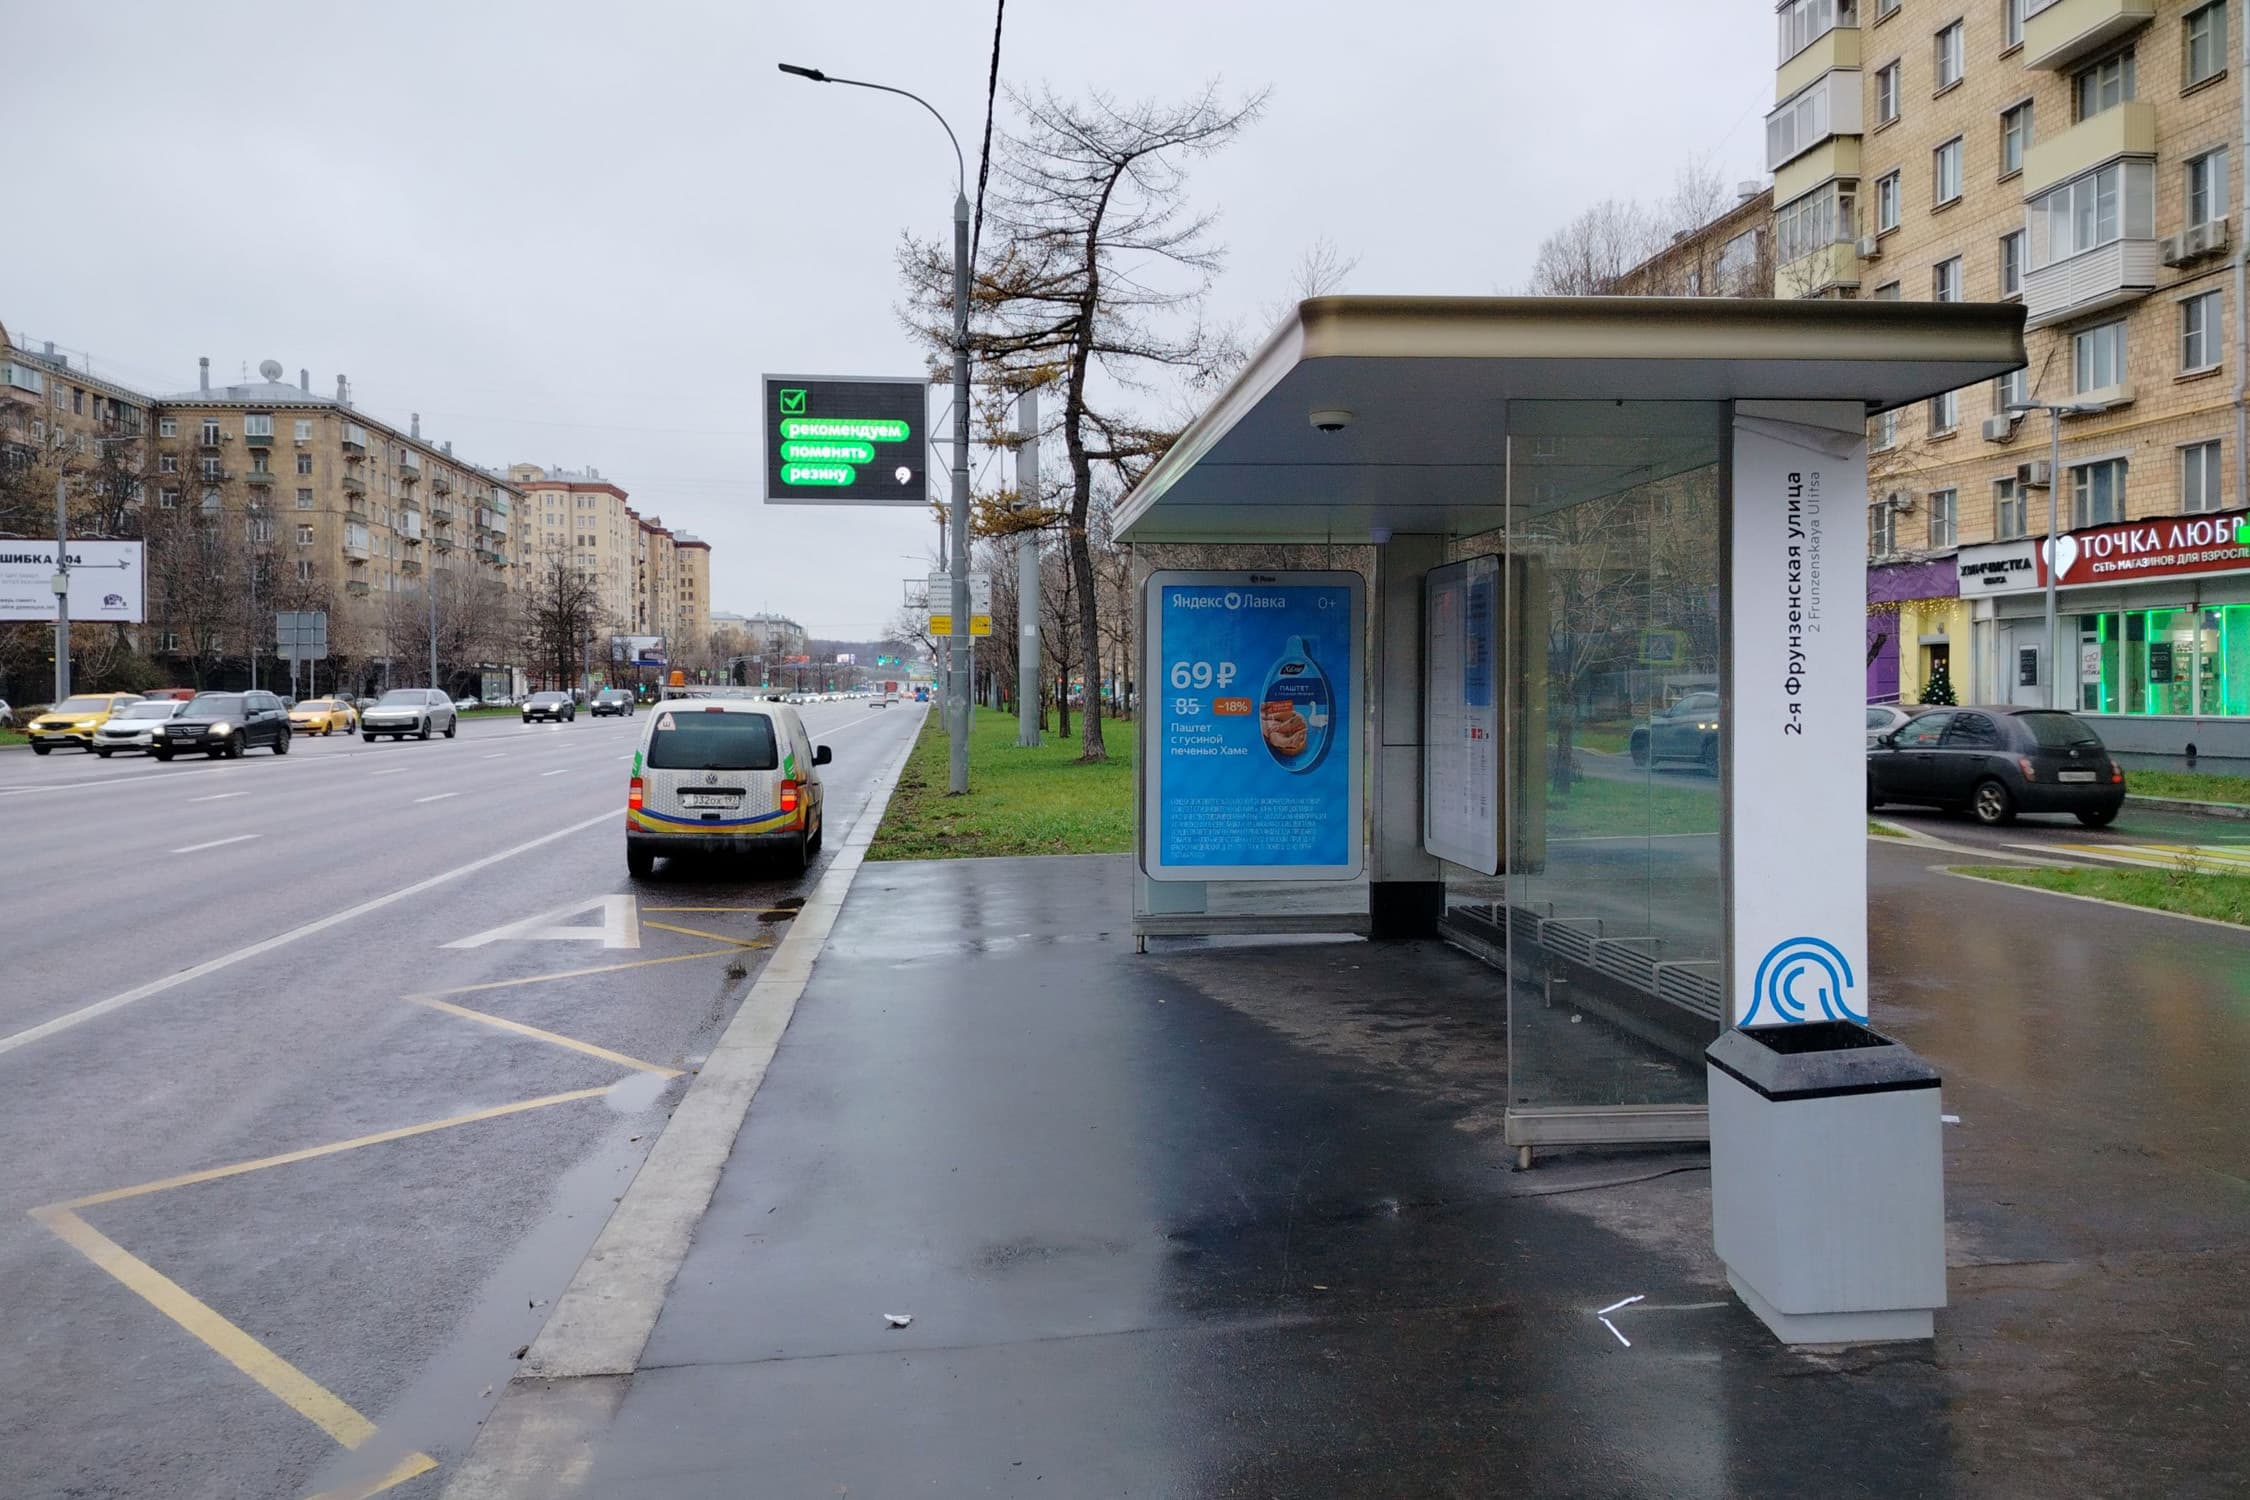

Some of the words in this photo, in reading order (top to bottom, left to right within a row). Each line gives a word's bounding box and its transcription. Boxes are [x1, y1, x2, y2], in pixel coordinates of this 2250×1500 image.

[789, 423, 902, 440] рекомендуем
[789, 445, 868, 459] поменять
[790, 467, 848, 484] резину
[1807, 471, 1821, 514] Ulitsa
[1787, 471, 1805, 540] улица
[2080, 526, 2161, 559] ТОЧКА
[56, 555, 82, 565] 04
[2092, 560, 2117, 573] СЕТЬ
[2117, 554, 2175, 571] МАГАЗИНОВ
[2176, 551, 2199, 566] ДЛЯ
[1807, 519, 1823, 619] Frunzenskaya
[1172, 593, 1223, 609] Яндекс
[1243, 594, 1286, 608] Лавка
[1317, 596, 1337, 610] 0+
[1784, 545, 1806, 695] Фрунзенская
[1808, 624, 1821, 633] 2
[1175, 697, 1200, 716] 85
[1217, 701, 1248, 712] -18%
[1784, 702, 1802, 735] 2-я
[1171, 722, 1212, 733] Паштет
[1170, 736, 1177, 744] с
[1179, 734, 1223, 746] гусиной
[1170, 747, 1218, 756] печенью
[1219, 746, 1249, 756] Хаме
